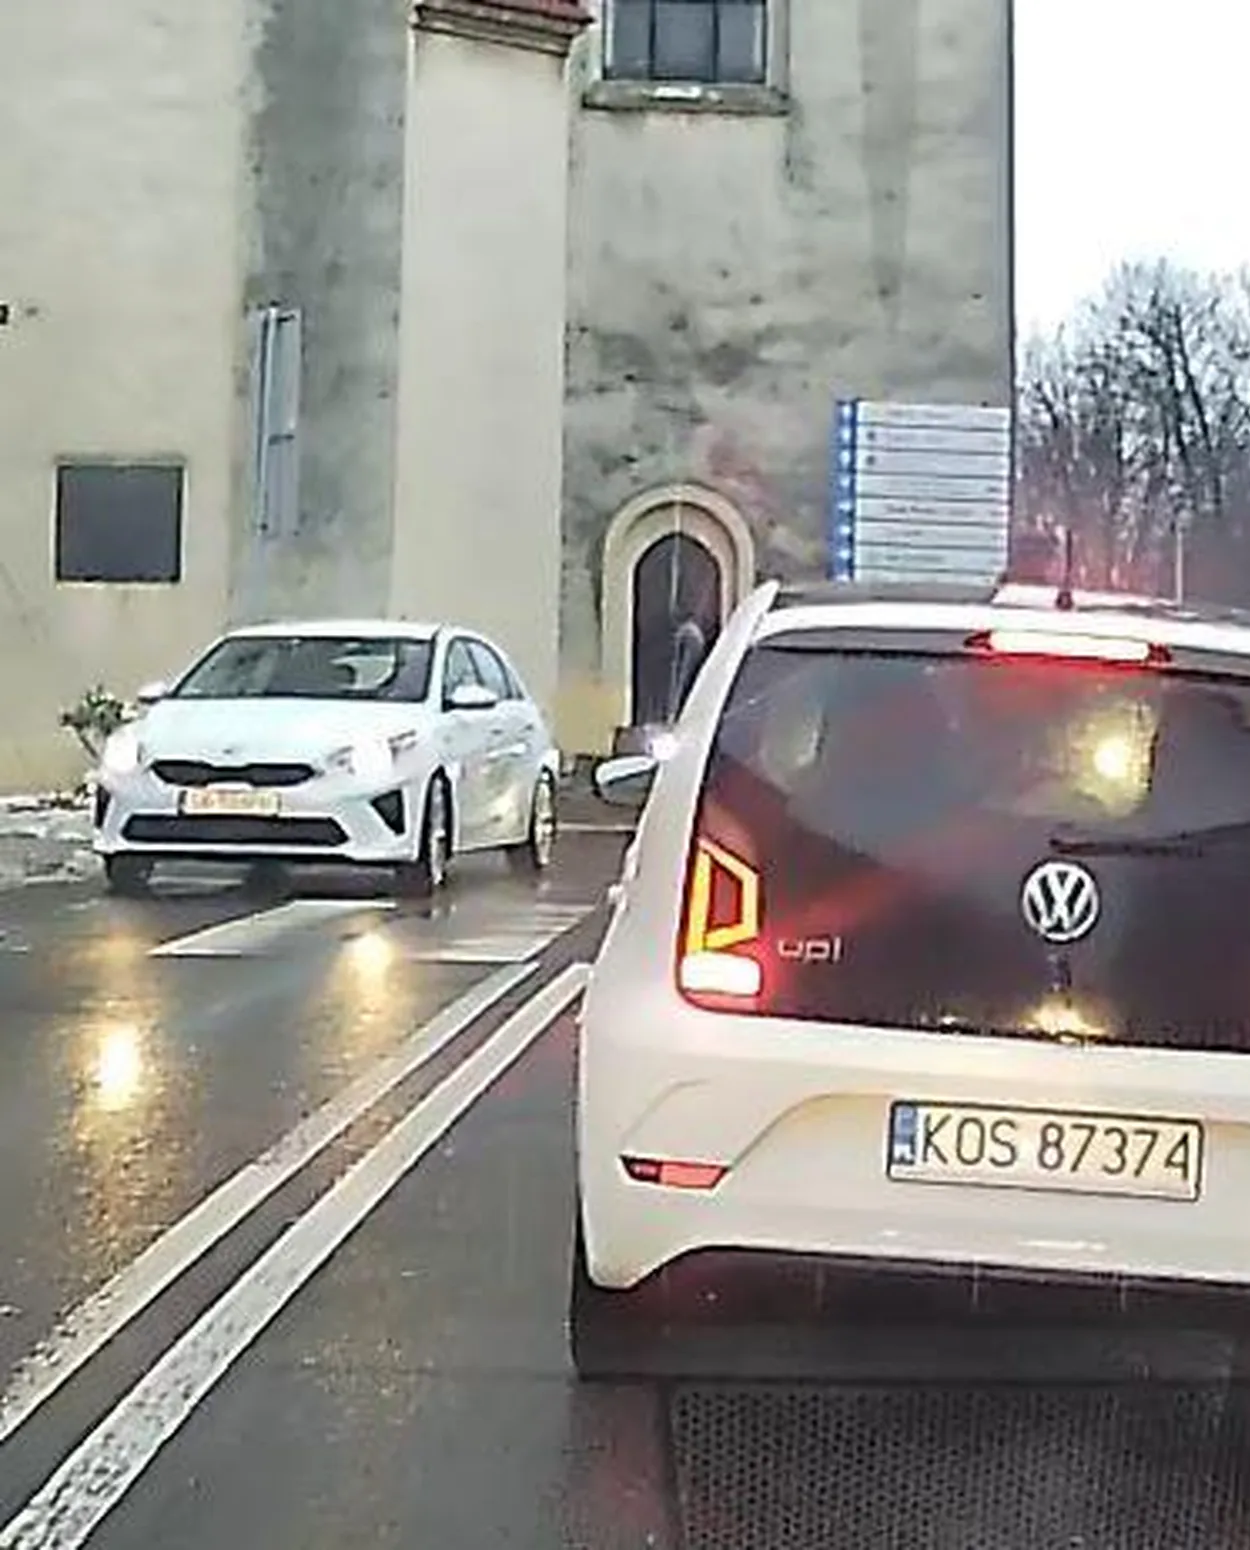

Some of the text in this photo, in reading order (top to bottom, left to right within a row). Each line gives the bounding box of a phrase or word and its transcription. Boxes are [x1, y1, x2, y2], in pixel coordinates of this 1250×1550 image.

[1023, 861, 1099, 942] VW
[777, 937, 842, 963] up!
[923, 1114, 1191, 1181] KOS 87374
